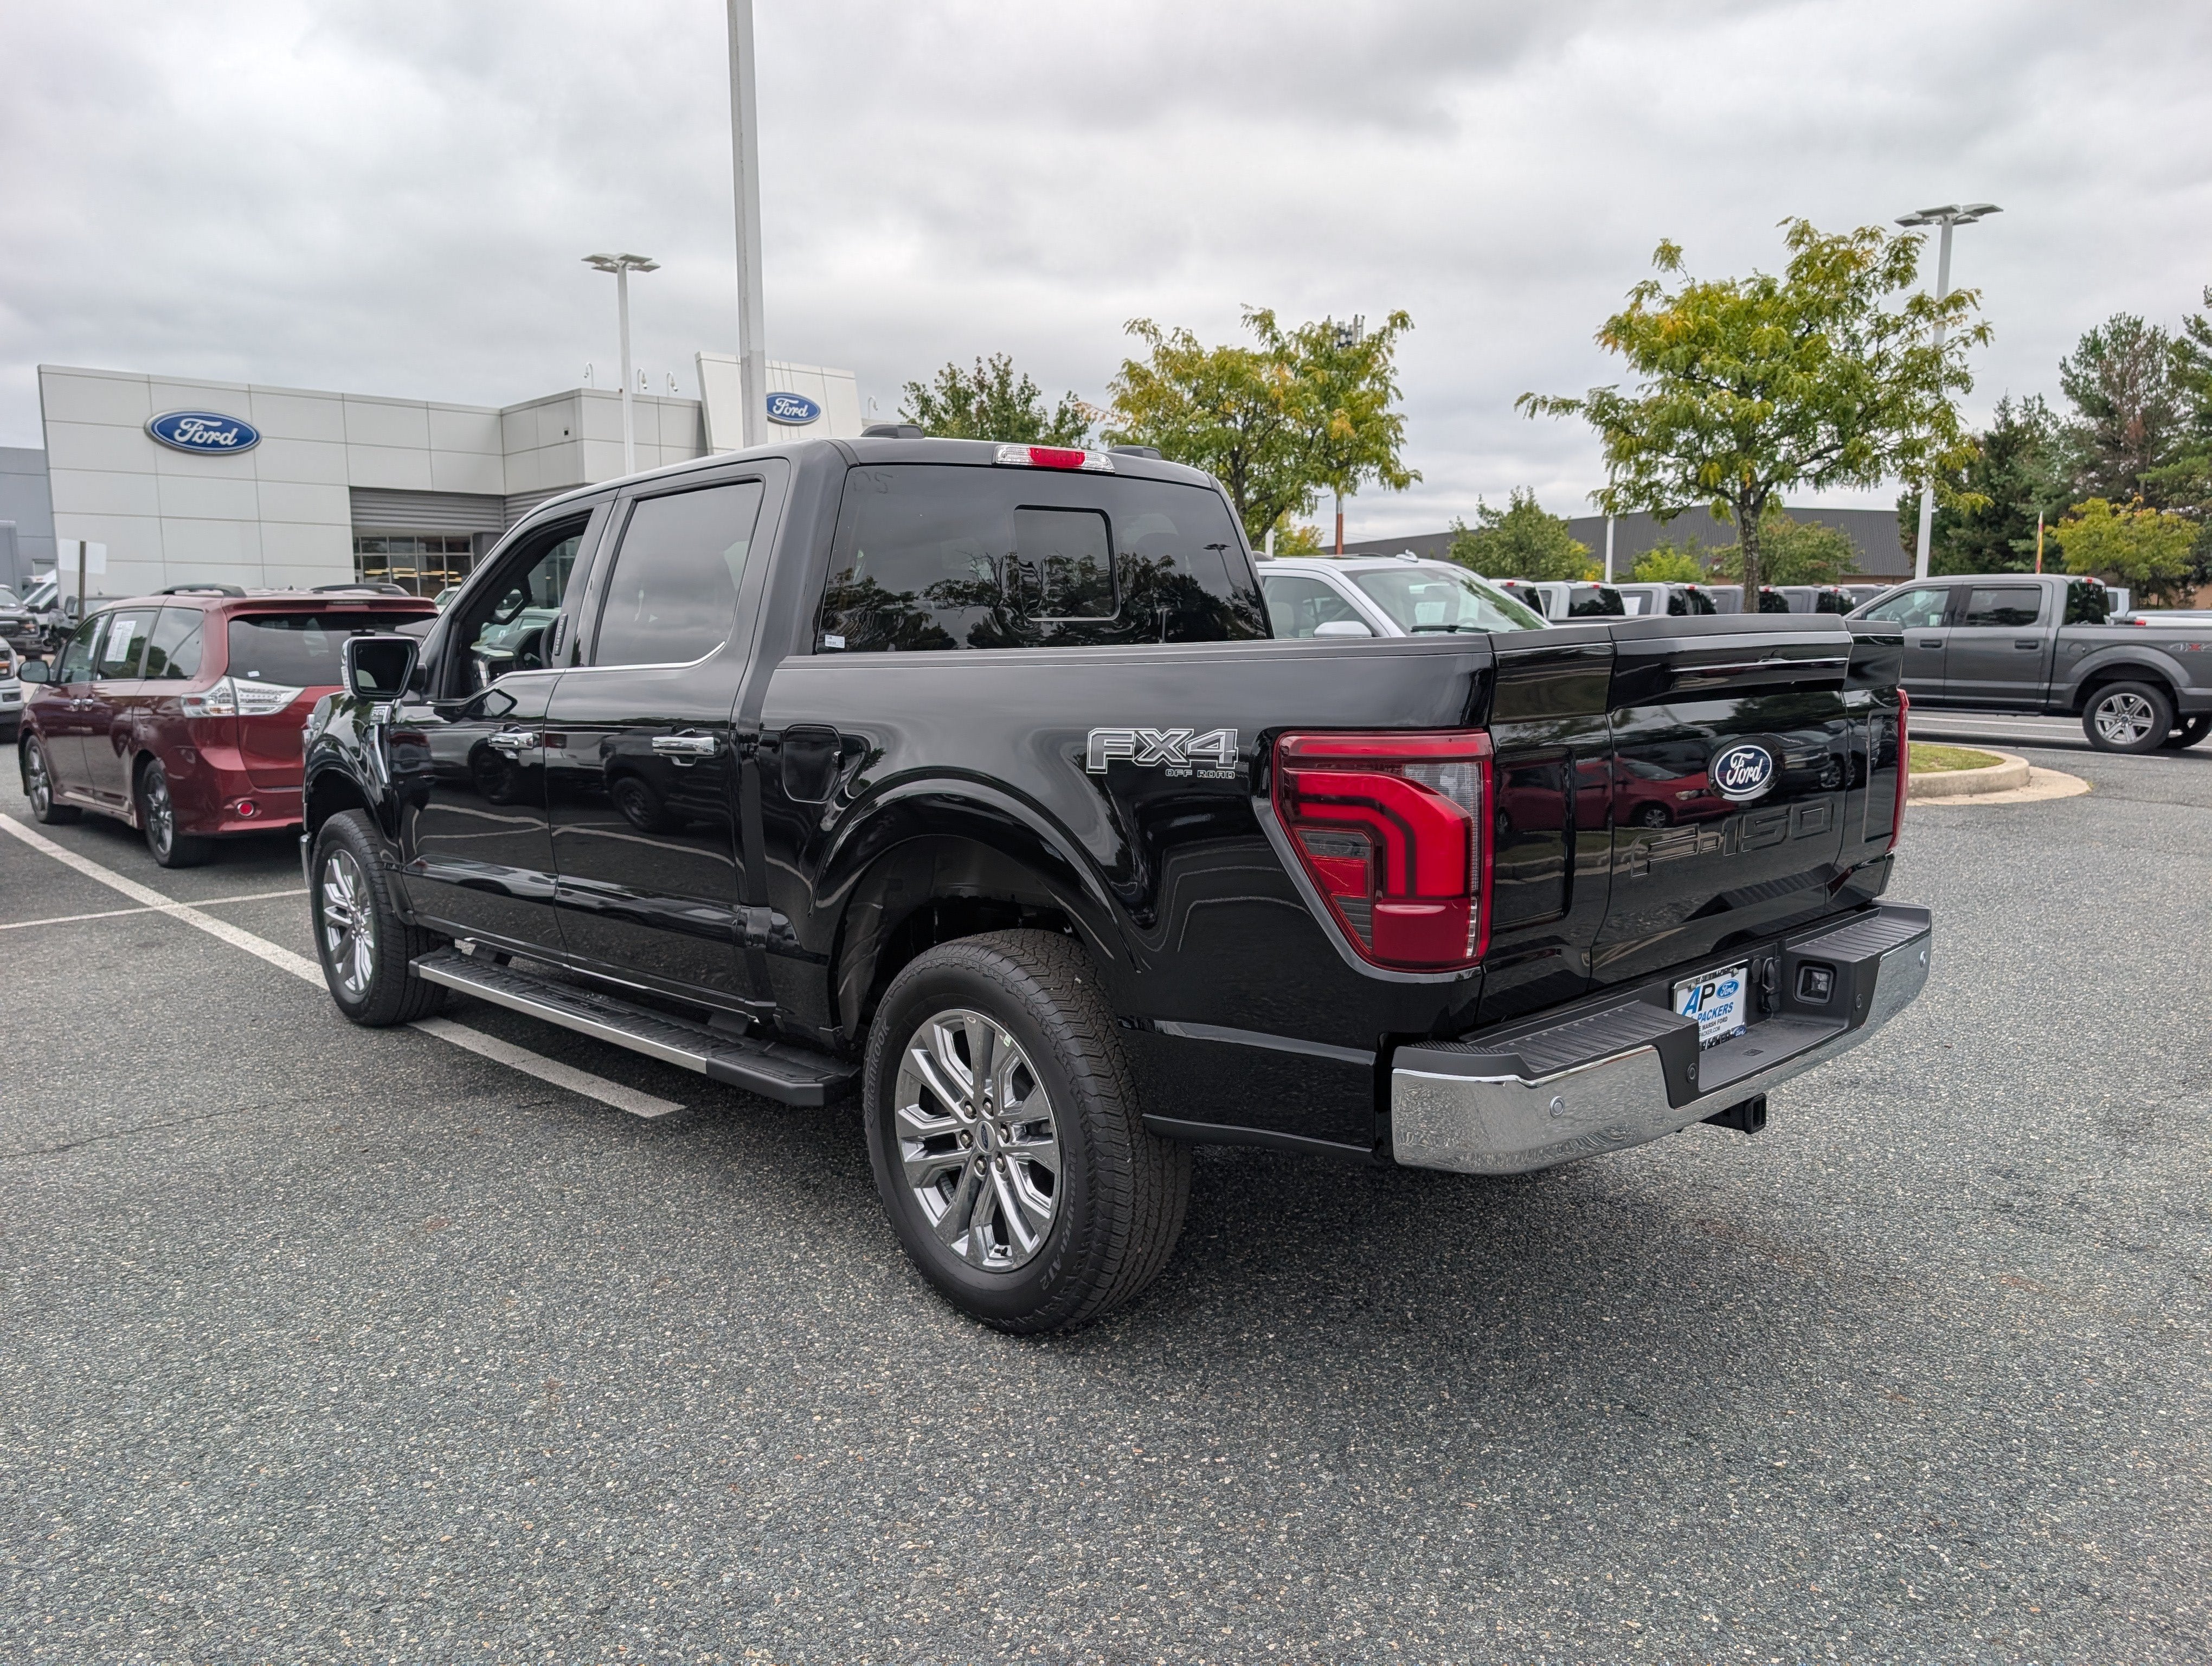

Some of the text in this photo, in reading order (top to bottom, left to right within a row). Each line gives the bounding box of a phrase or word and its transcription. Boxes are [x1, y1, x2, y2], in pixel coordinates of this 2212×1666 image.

[773, 398, 808, 417] Ford
[174, 418, 239, 445] Ford
[1086, 727, 1238, 774] FX4
[1166, 768, 1236, 779] OFF ROAD
[1726, 752, 1763, 786] Ford
[1630, 796, 1834, 879] F-150
[1682, 983, 1715, 1017] AP
[1720, 982, 1735, 997] Ford
[1697, 1001, 1734, 1024] PACKERS
[1702, 1020, 1716, 1030] MARSH
[1717, 1016, 1728, 1024] FORD
